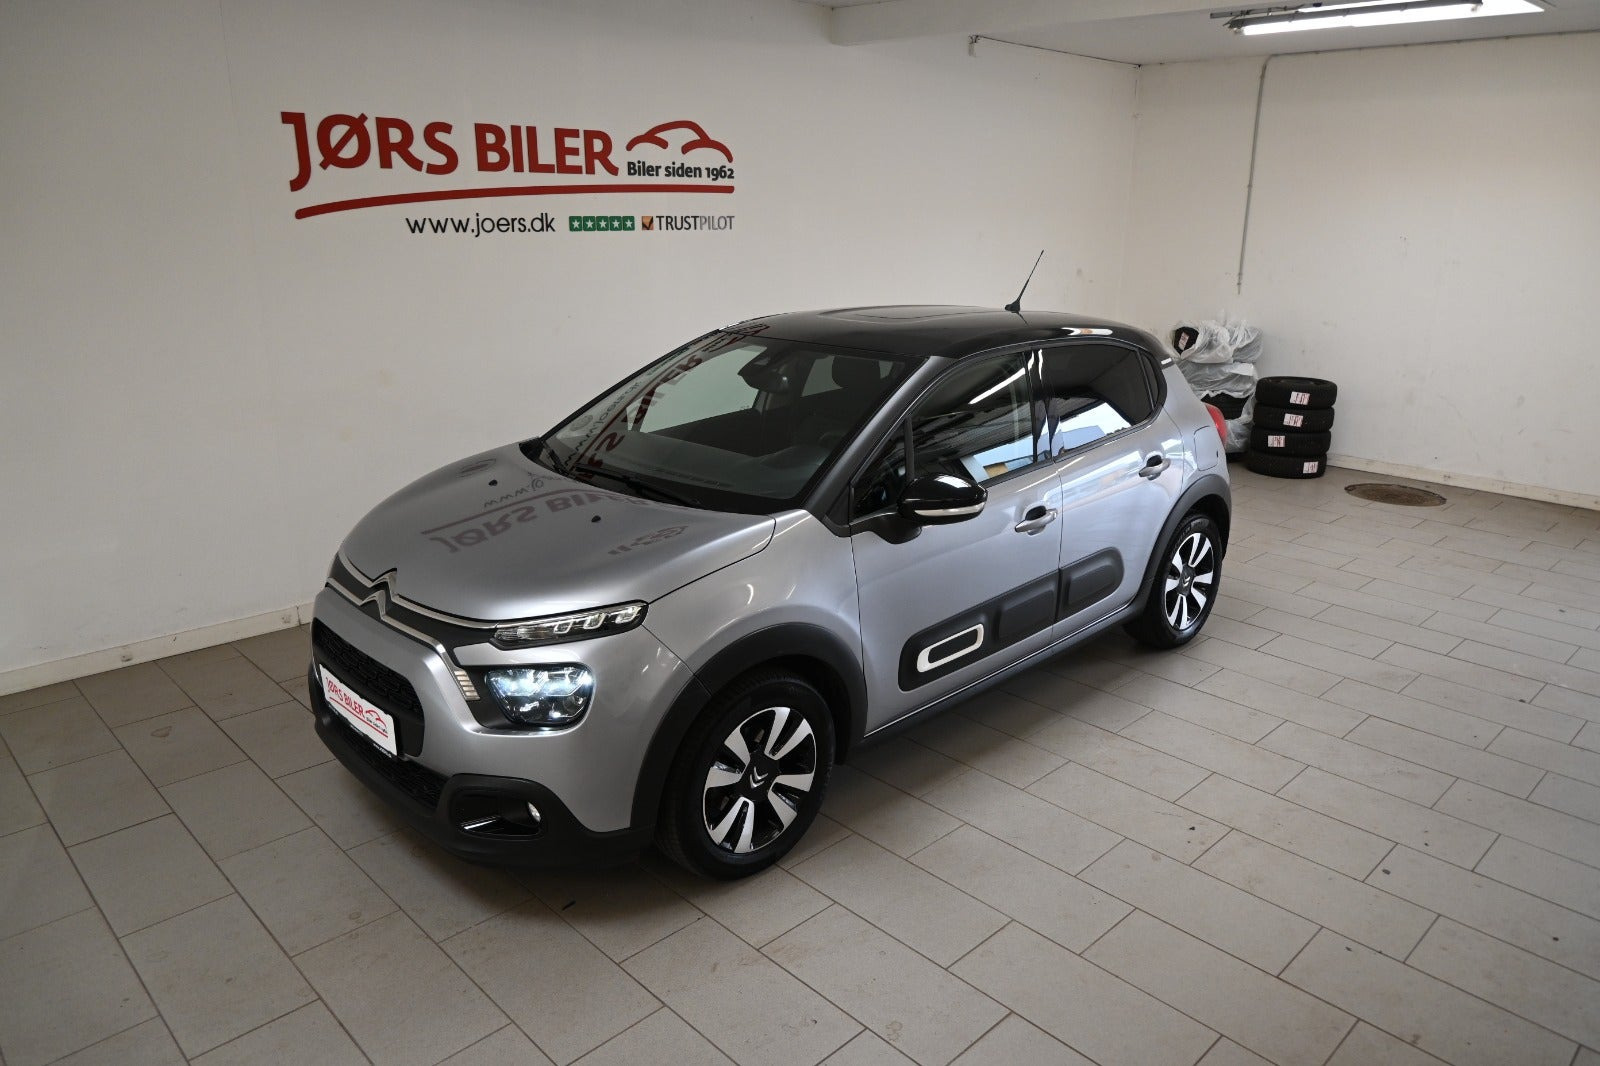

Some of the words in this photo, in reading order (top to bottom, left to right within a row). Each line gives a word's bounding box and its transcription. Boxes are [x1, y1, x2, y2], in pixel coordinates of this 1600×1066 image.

[281, 112, 459, 192] JØRS
[475, 122, 619, 176] BILER
[627, 160, 662, 177] Biler
[665, 163, 703, 178] siden
[704, 165, 735, 182] 1962
[405, 212, 556, 238] www.joers.dk
[656, 215, 735, 231] TRUSTPILOT
